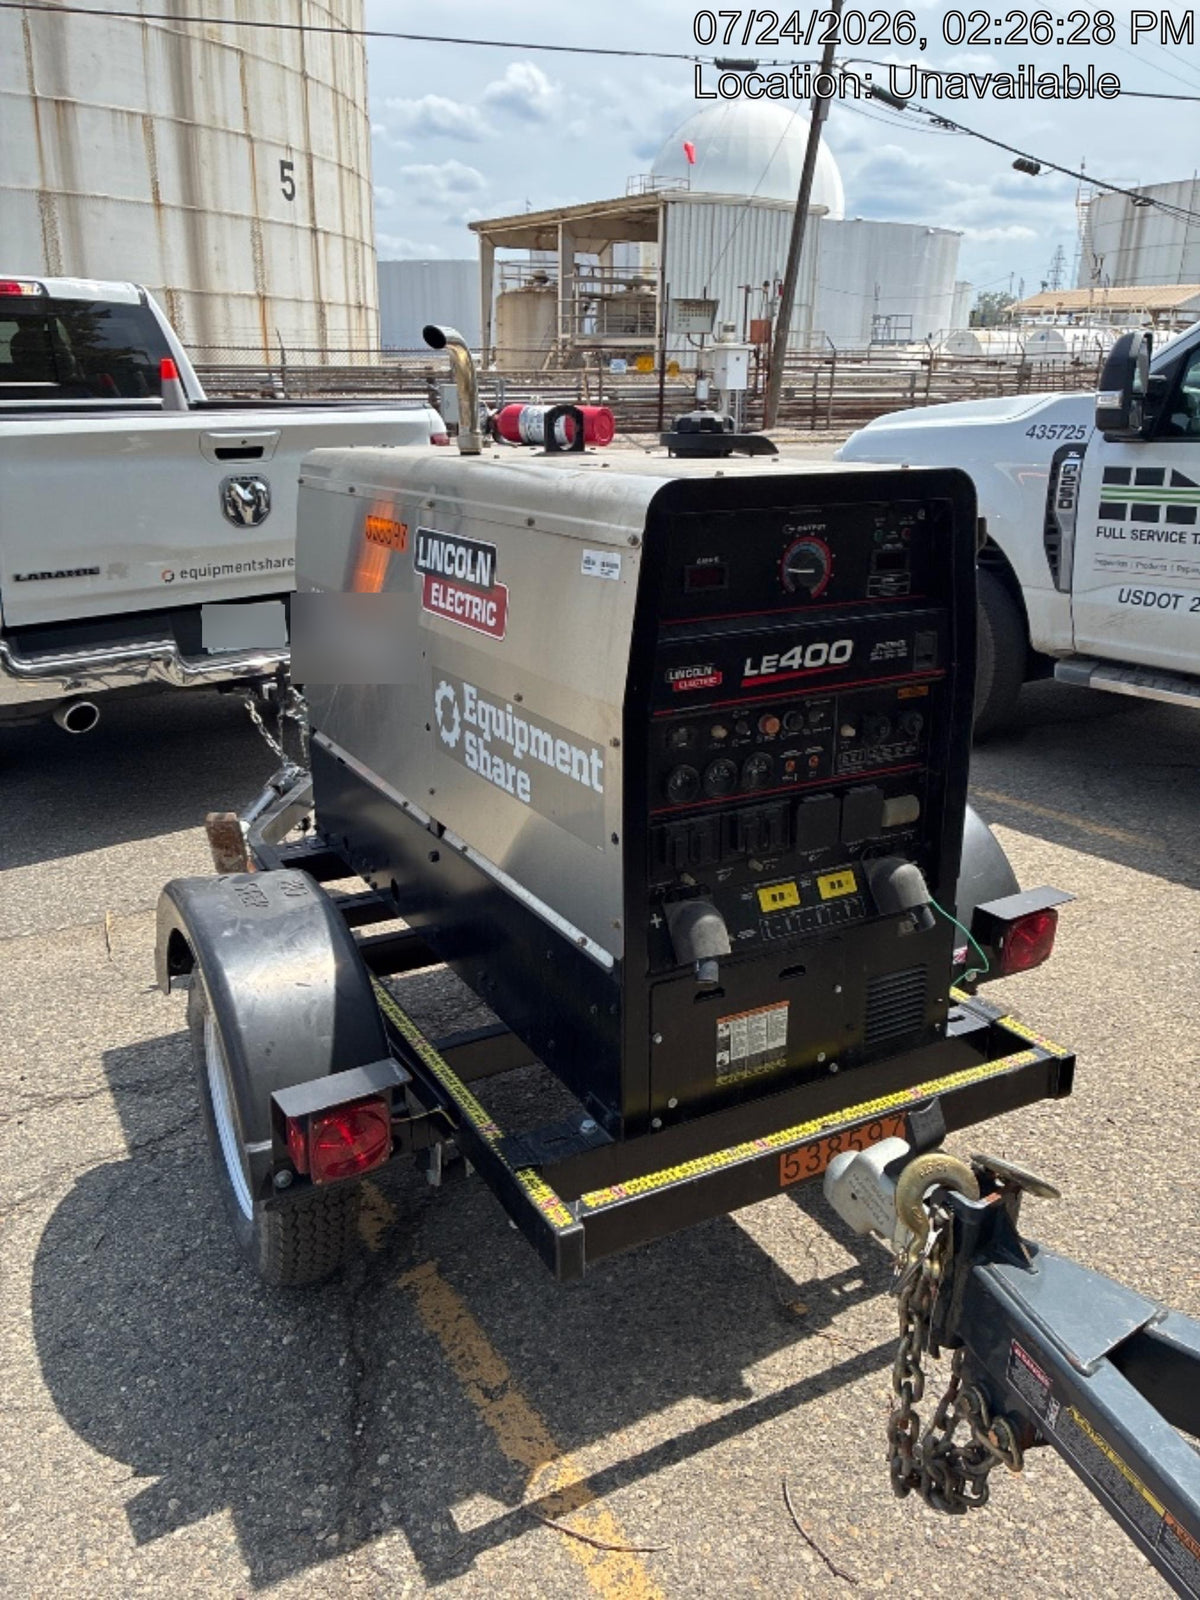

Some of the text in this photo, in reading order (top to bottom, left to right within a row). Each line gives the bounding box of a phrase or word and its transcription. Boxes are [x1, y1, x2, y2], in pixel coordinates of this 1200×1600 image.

[280, 160, 295, 201] 5
[1025, 425, 1087, 440] 435725
[1096, 526, 1127, 539] FULL
[1131, 529, 1188, 544] SERVICE
[13, 566, 100, 582] LARAMIE
[180, 557, 294, 580] equipmentshare
[417, 535, 493, 588] LINCOLN
[430, 582, 498, 628] ELECTRIC
[1118, 587, 1184, 611] USDOT
[668, 666, 712, 682] LINCOLN
[743, 639, 854, 677] LE400
[462, 682, 604, 794] Equipment
[464, 729, 531, 803] Share
[782, 1112, 904, 1180] 538597
